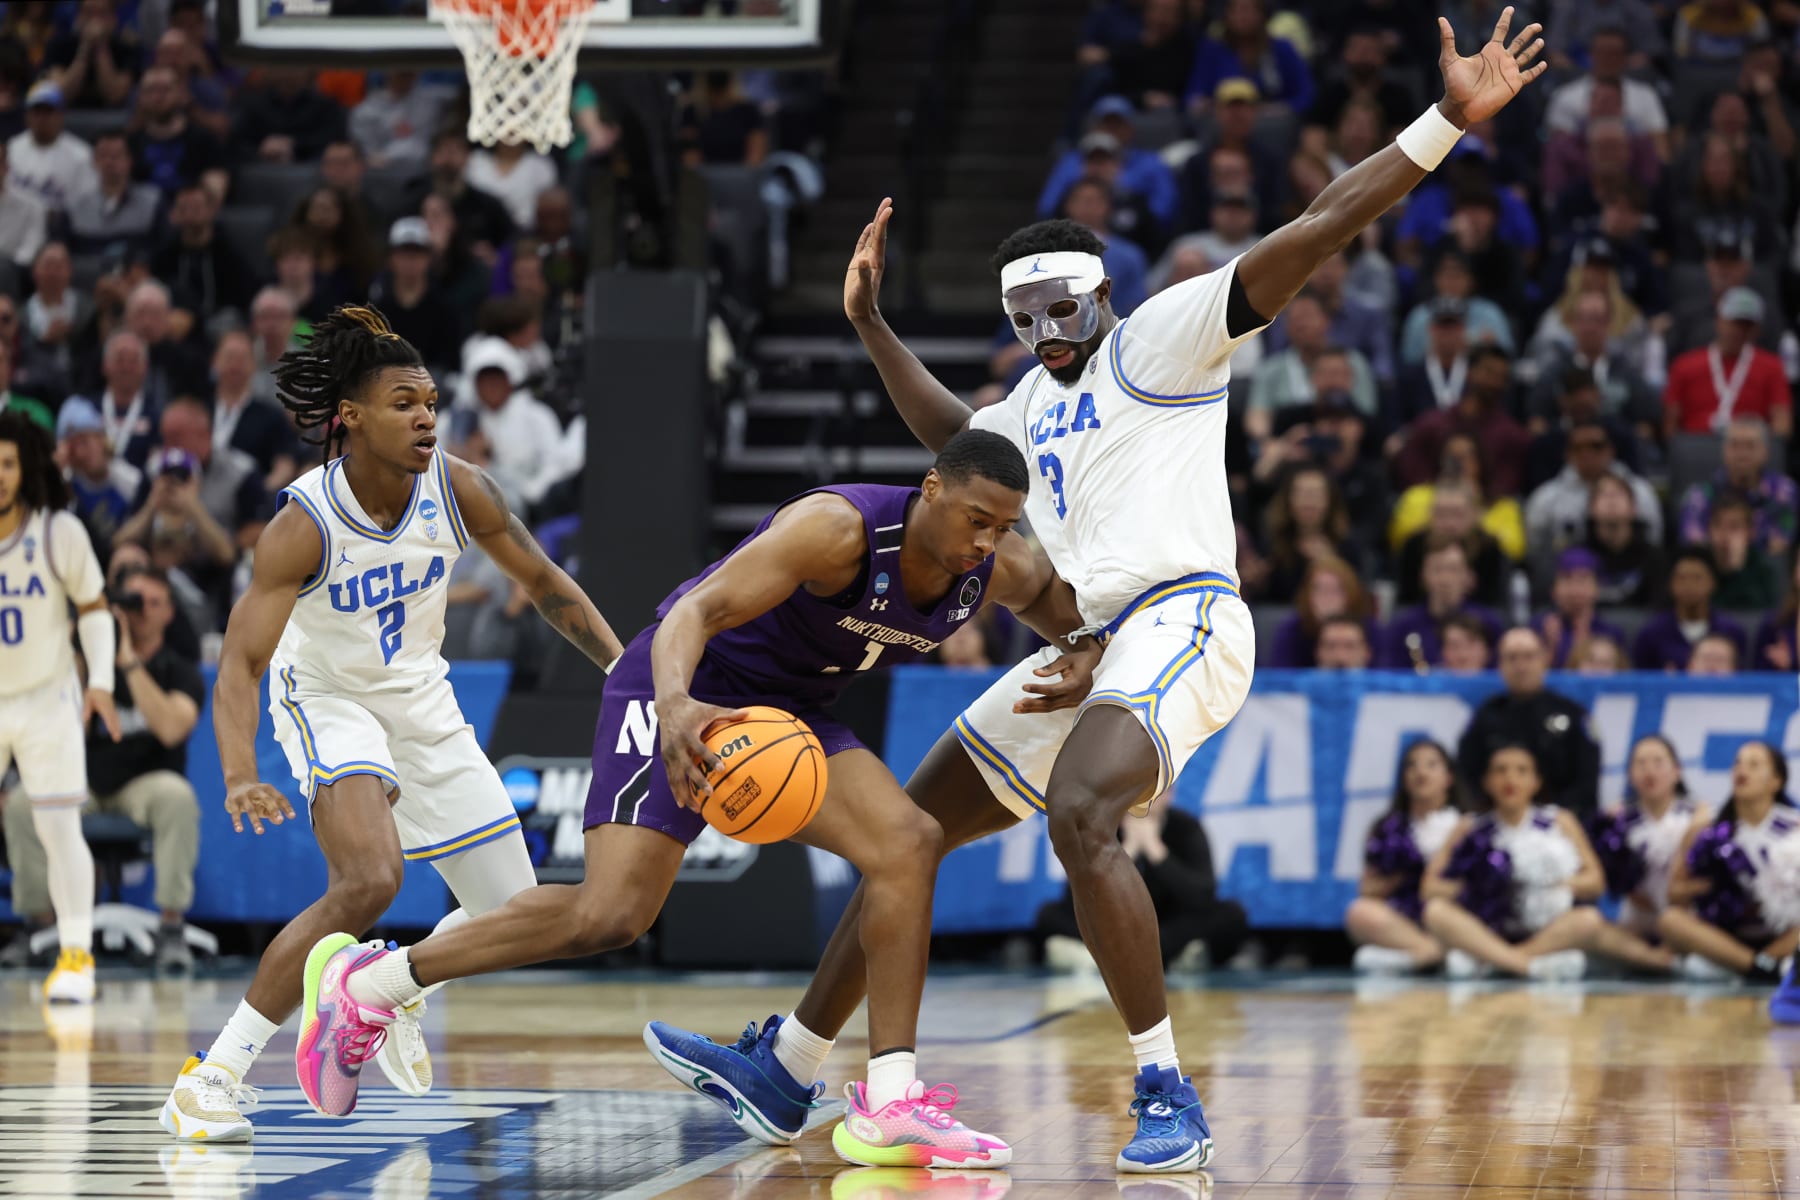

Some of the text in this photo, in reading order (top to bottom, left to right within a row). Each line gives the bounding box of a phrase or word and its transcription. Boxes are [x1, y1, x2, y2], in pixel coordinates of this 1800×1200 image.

[1029, 392, 1102, 446] CLA
[1037, 451, 1068, 521] 3
[328, 556, 445, 613] UCLA
[376, 600, 406, 667] 2
[614, 699, 660, 757] N
